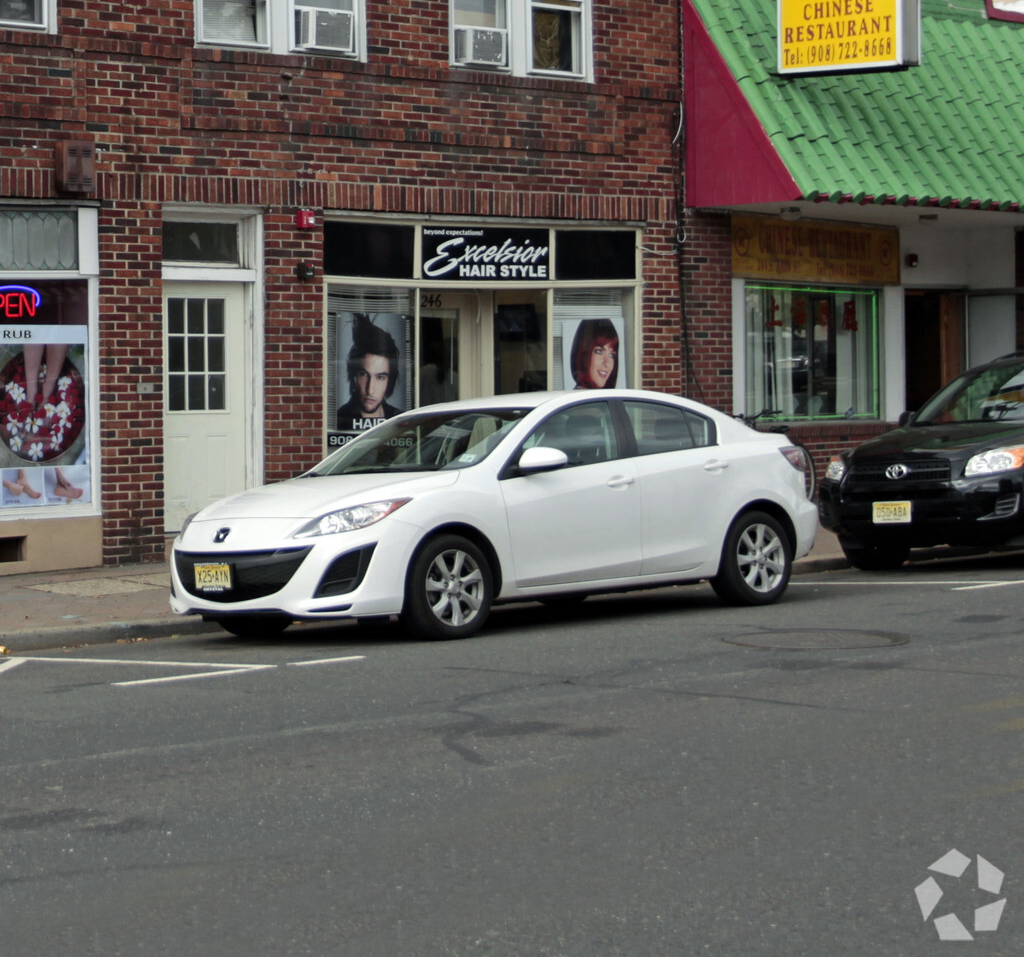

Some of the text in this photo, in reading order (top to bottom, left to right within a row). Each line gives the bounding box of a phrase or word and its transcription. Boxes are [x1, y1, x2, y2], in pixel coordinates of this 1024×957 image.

[784, 15, 892, 44] RESTAURANT
[784, 47, 804, 65] Tel:
[807, 44, 835, 64] (908)
[423, 228, 445, 236] beyond
[423, 237, 548, 277] Excelsior
[459, 264, 546, 277] HAIR STYLE
[421, 293, 442, 308] 246
[3, 329, 32, 339] RUB
